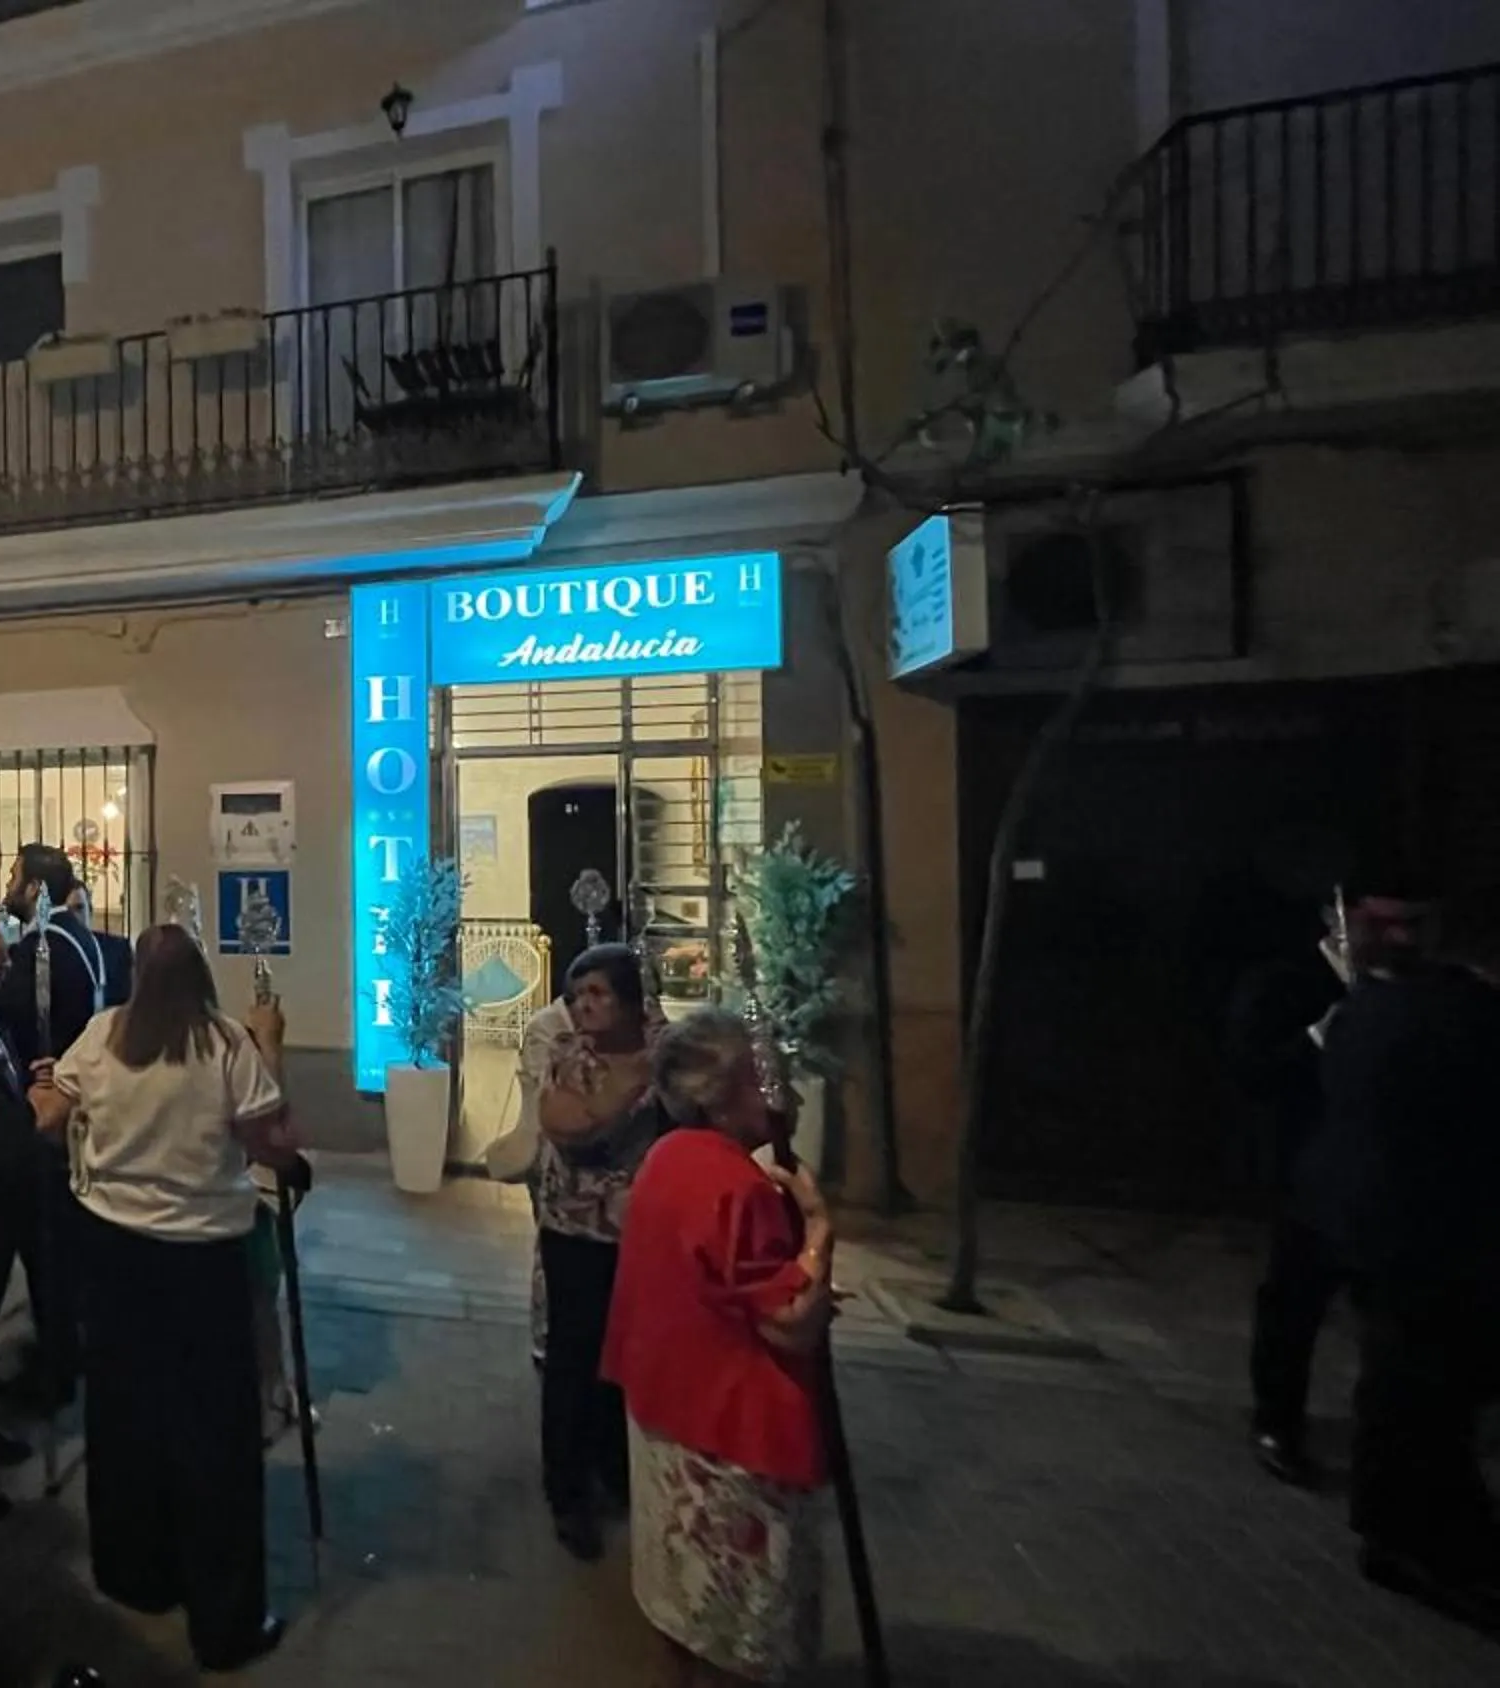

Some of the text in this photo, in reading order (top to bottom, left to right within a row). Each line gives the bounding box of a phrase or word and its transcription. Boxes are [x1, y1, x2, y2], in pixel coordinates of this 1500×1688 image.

[740, 563, 762, 591] H
[446, 570, 715, 622] BOUTIQUE
[379, 598, 399, 625] H
